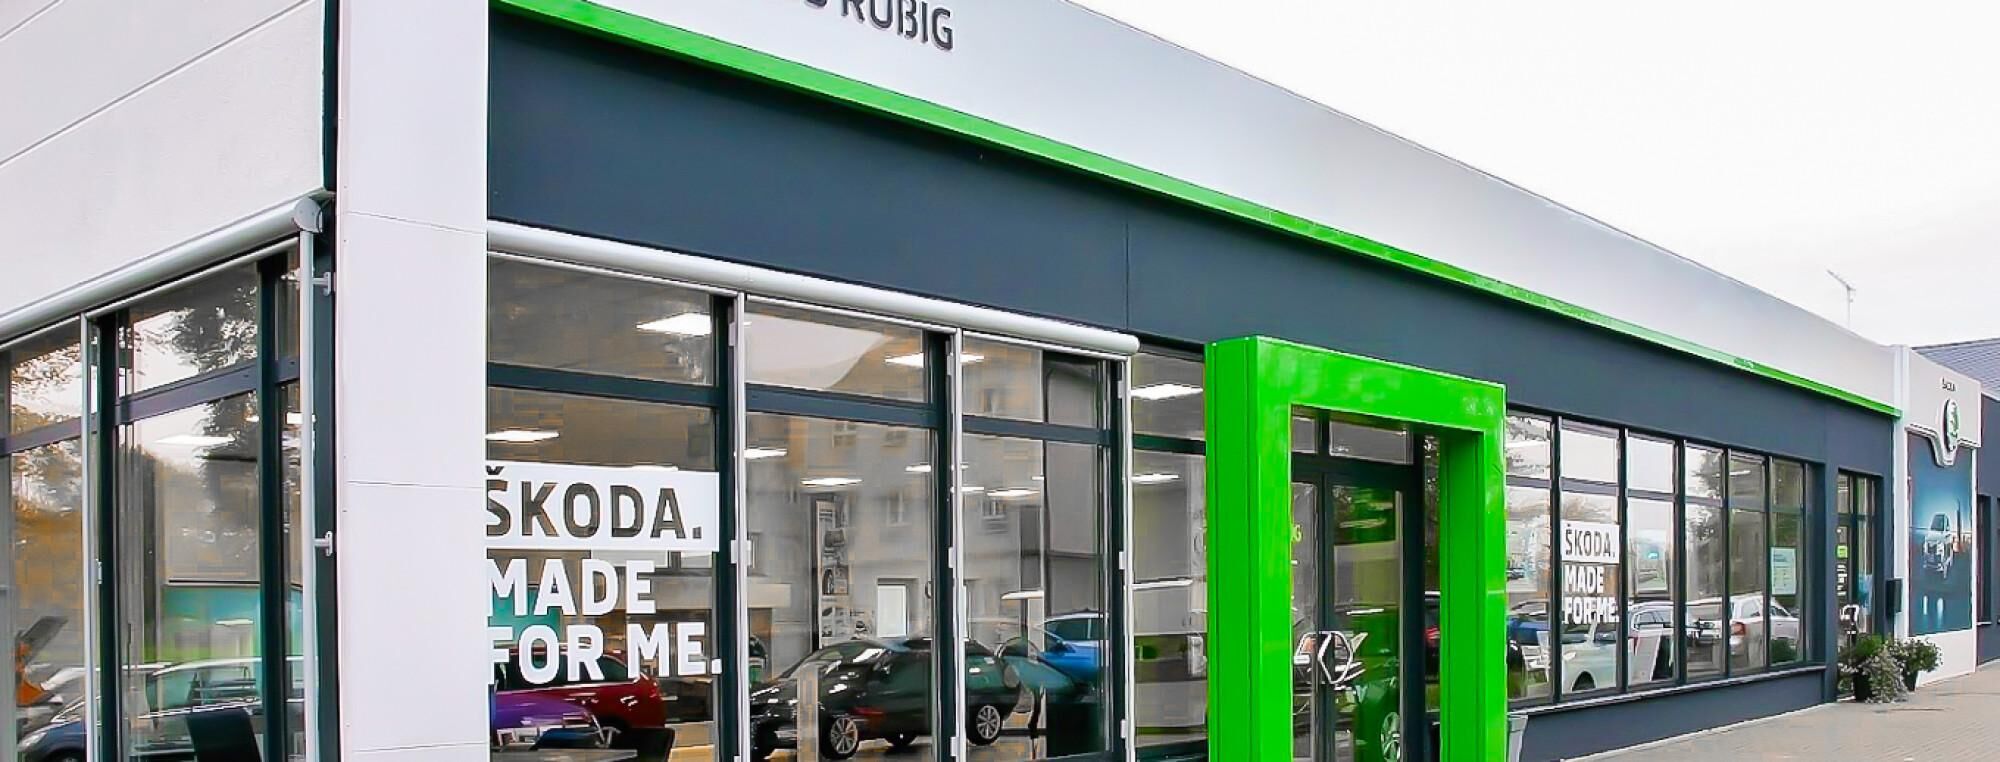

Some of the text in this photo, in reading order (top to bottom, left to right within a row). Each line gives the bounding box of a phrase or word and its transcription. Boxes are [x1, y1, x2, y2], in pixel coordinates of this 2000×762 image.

[486, 465, 702, 539] ŠKODA.
[1565, 524, 1615, 557] ŠKODA.
[487, 558, 656, 616] MADE
[1564, 565, 1604, 594] MADE
[1564, 597, 1596, 624] FOR
[487, 621, 722, 685] FOR ME.
